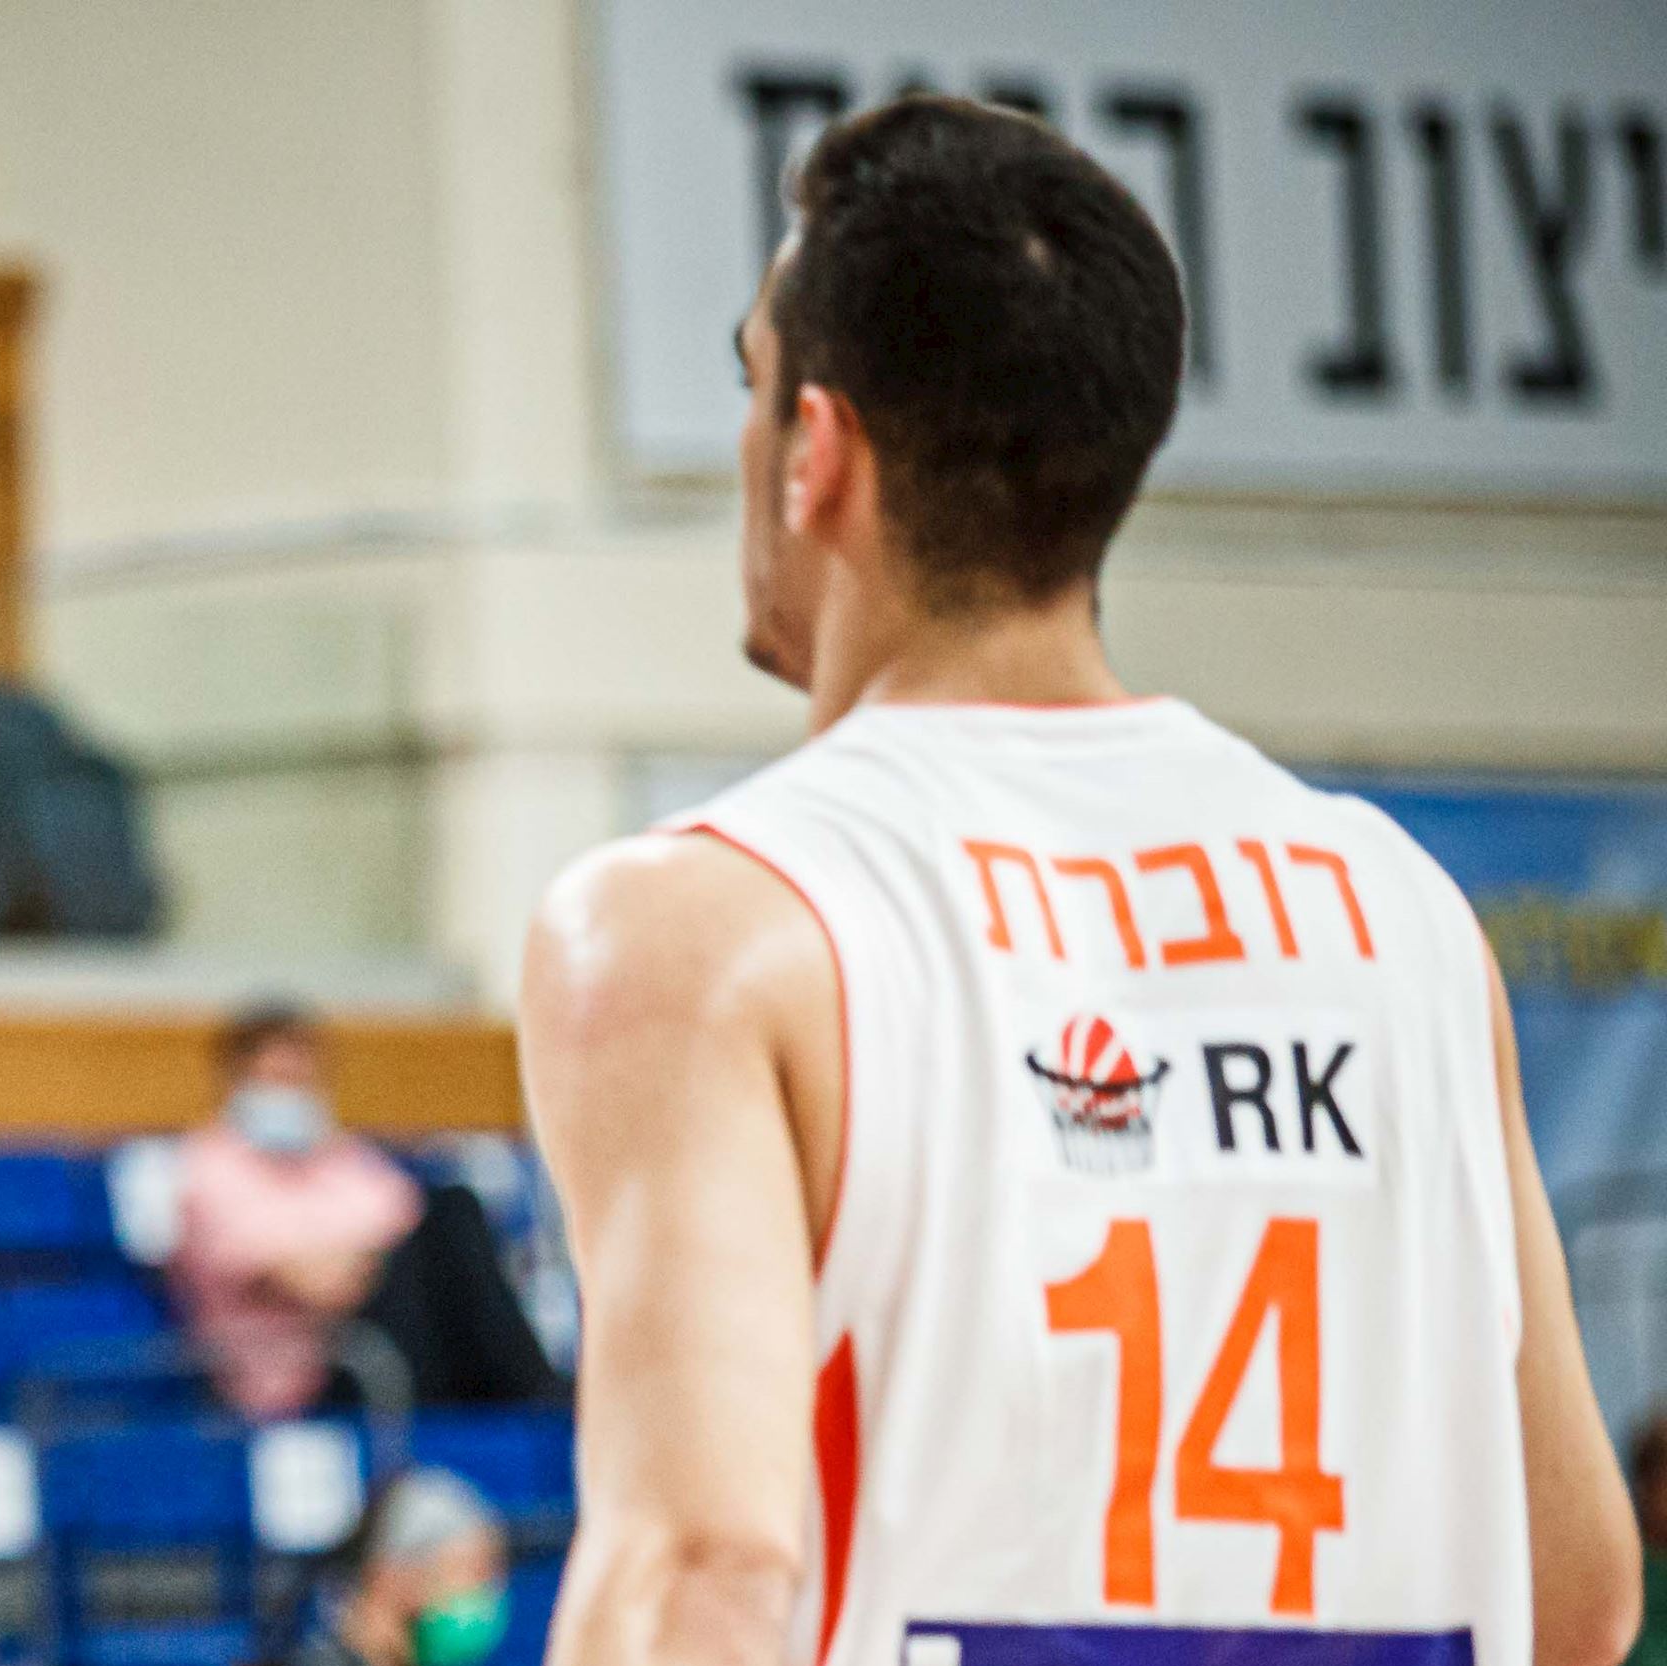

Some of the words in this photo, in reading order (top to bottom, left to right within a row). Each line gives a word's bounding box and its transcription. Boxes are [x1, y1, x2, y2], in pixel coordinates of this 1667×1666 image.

[962, 838, 1377, 971] רוברת
[1203, 1040, 1365, 1159] RK
[1042, 1217, 1345, 1617] 14
